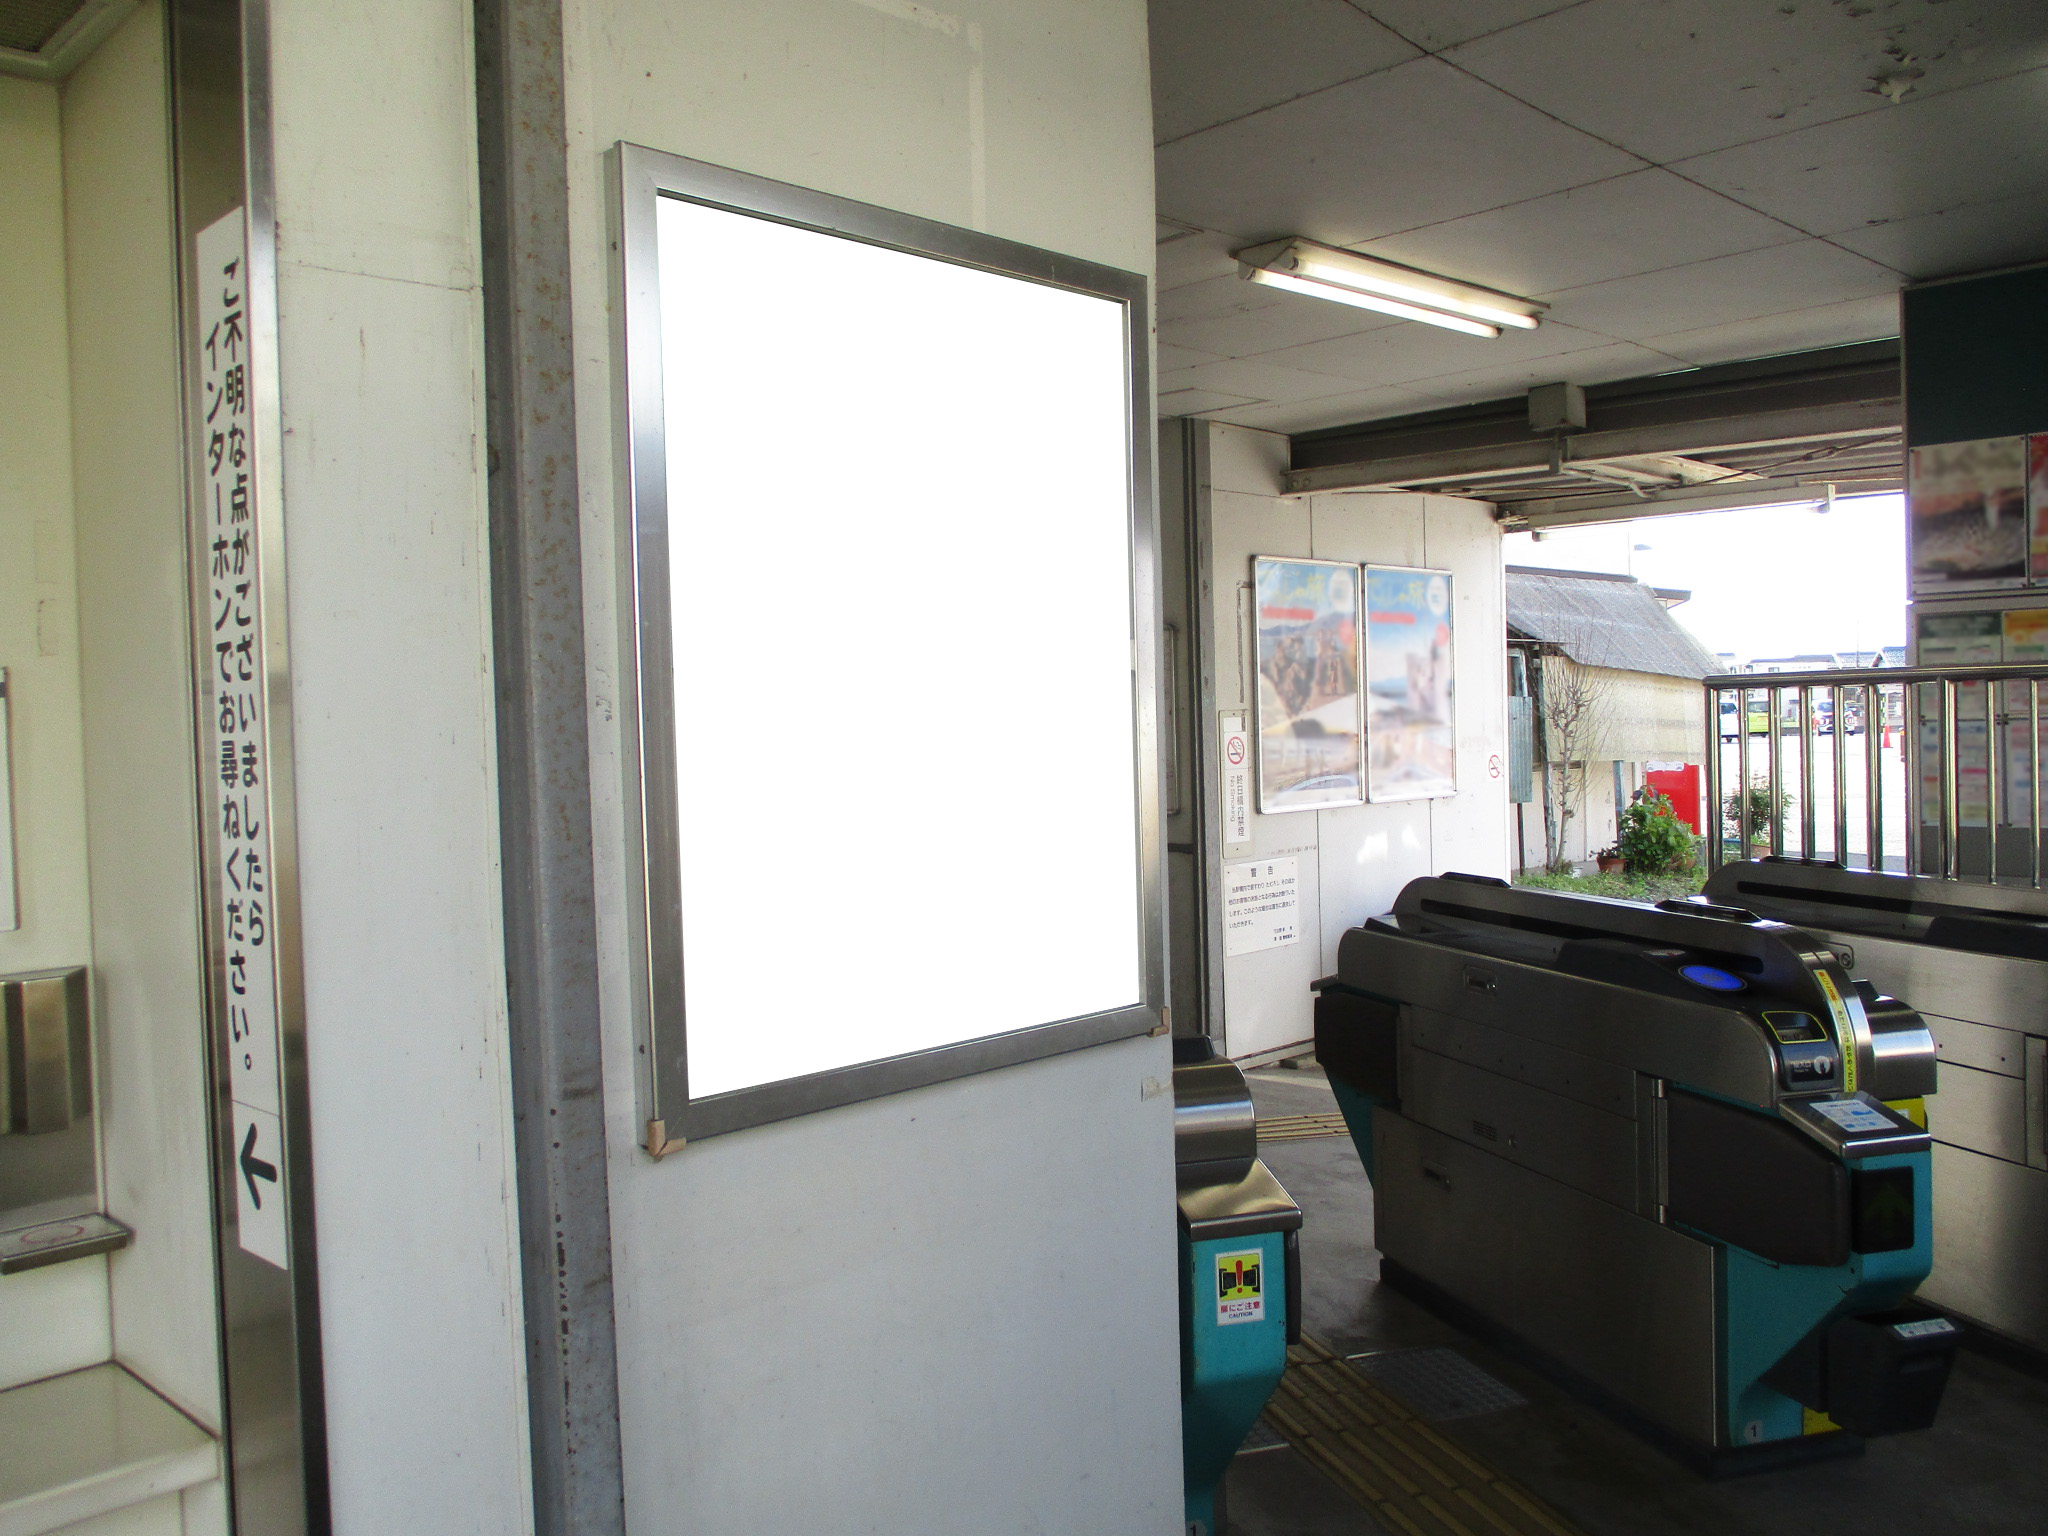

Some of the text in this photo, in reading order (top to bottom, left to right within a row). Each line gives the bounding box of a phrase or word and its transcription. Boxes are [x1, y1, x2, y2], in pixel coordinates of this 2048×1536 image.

[205, 320, 253, 1072] インターホンでお尋ねください。
[1230, 776, 1236, 787] No
[1229, 1311, 1253, 1319] CAUTION
[1750, 1424, 1758, 1438] 1
